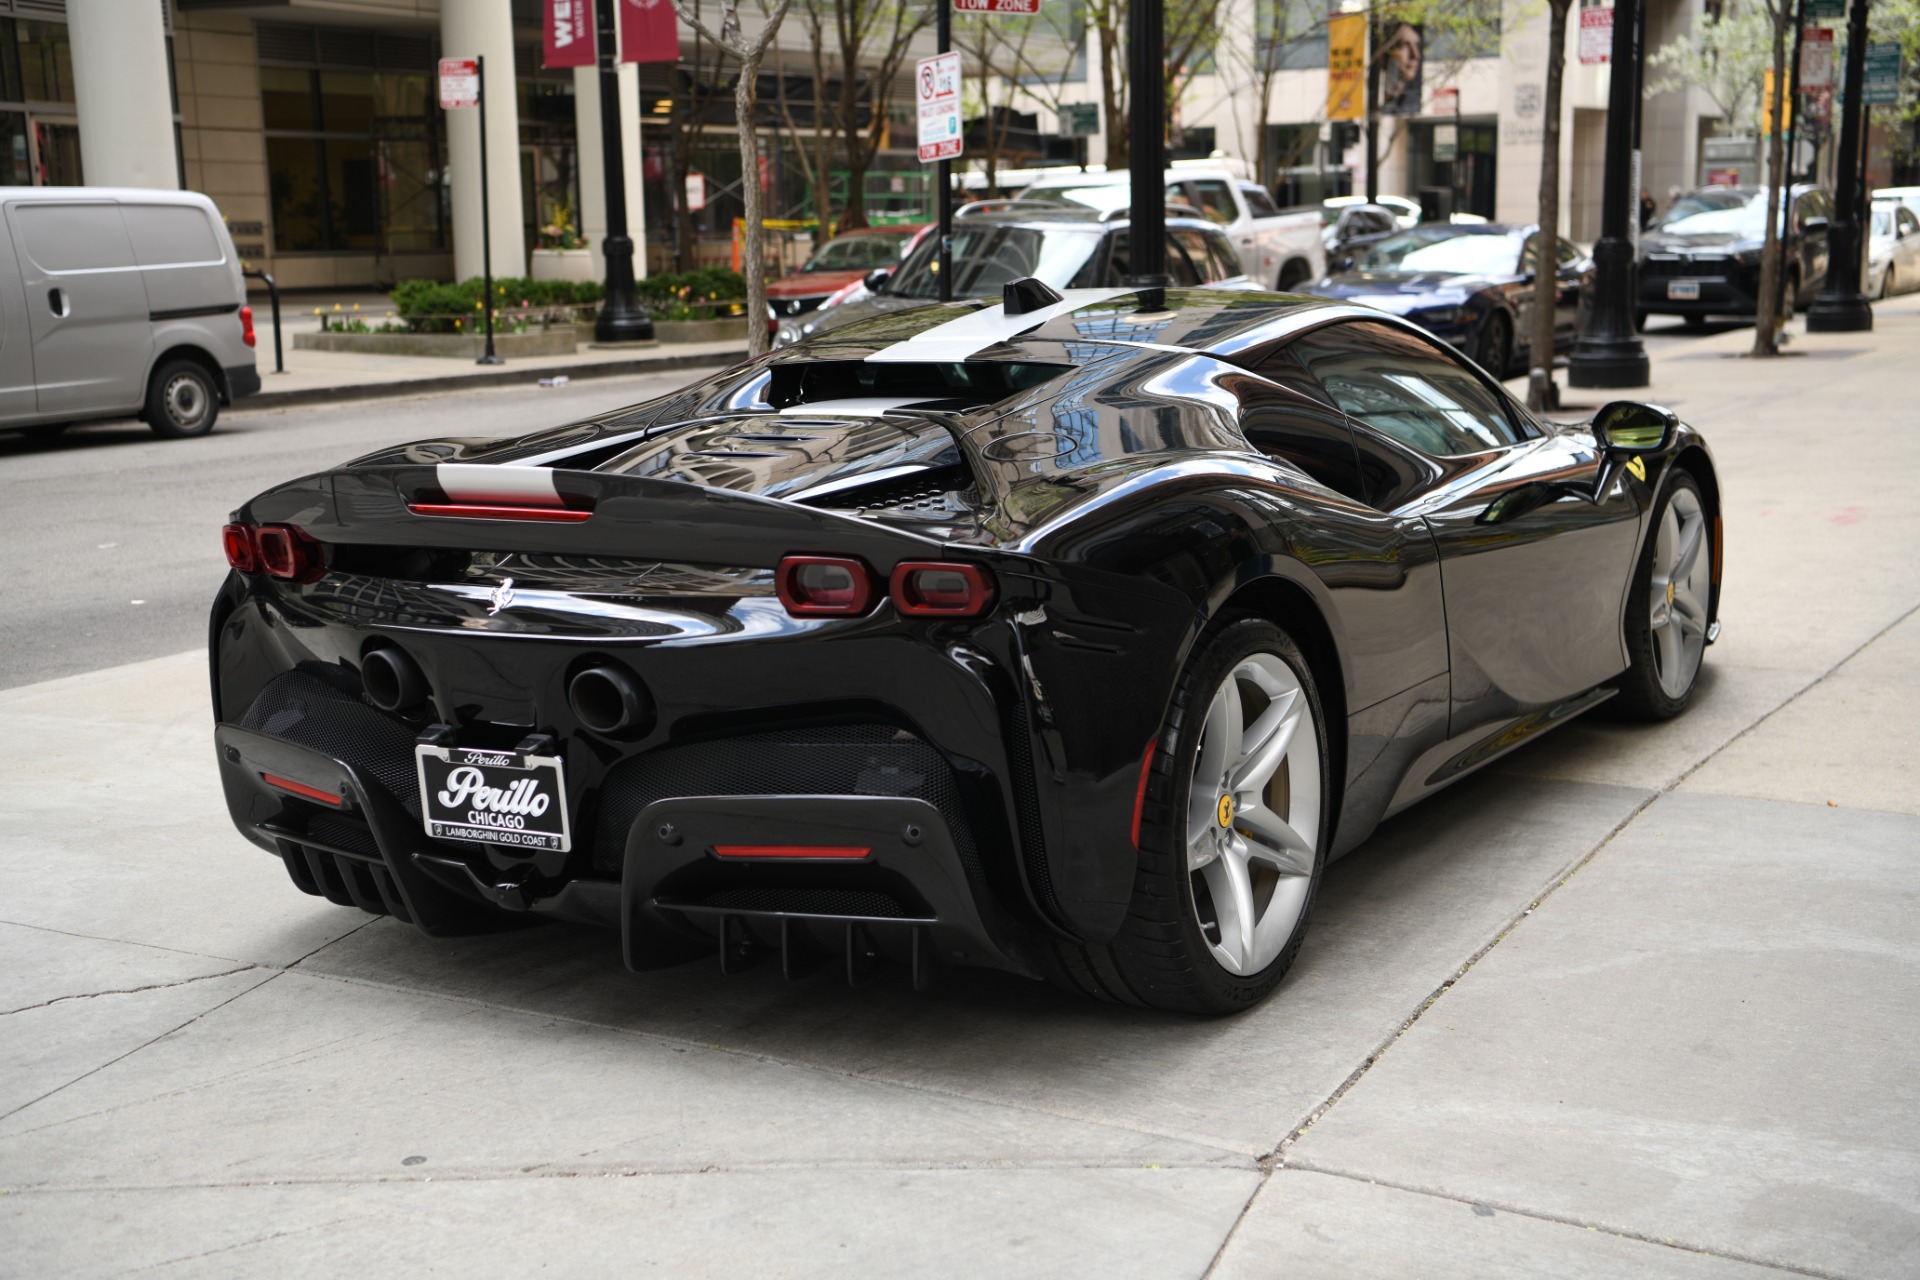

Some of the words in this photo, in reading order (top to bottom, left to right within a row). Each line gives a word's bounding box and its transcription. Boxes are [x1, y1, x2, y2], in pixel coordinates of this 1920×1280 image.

[961, 0, 987, 9] TOW
[995, 0, 1032, 11] ZONE
[553, 0, 573, 49] WE
[464, 751, 510, 766] Perillo
[438, 767, 549, 817] Perillo
[468, 811, 524, 829] CHICAGO
[446, 827, 498, 841] LAMBORGHINI
[499, 832, 520, 844] GOLD
[522, 835, 546, 846] COAST
